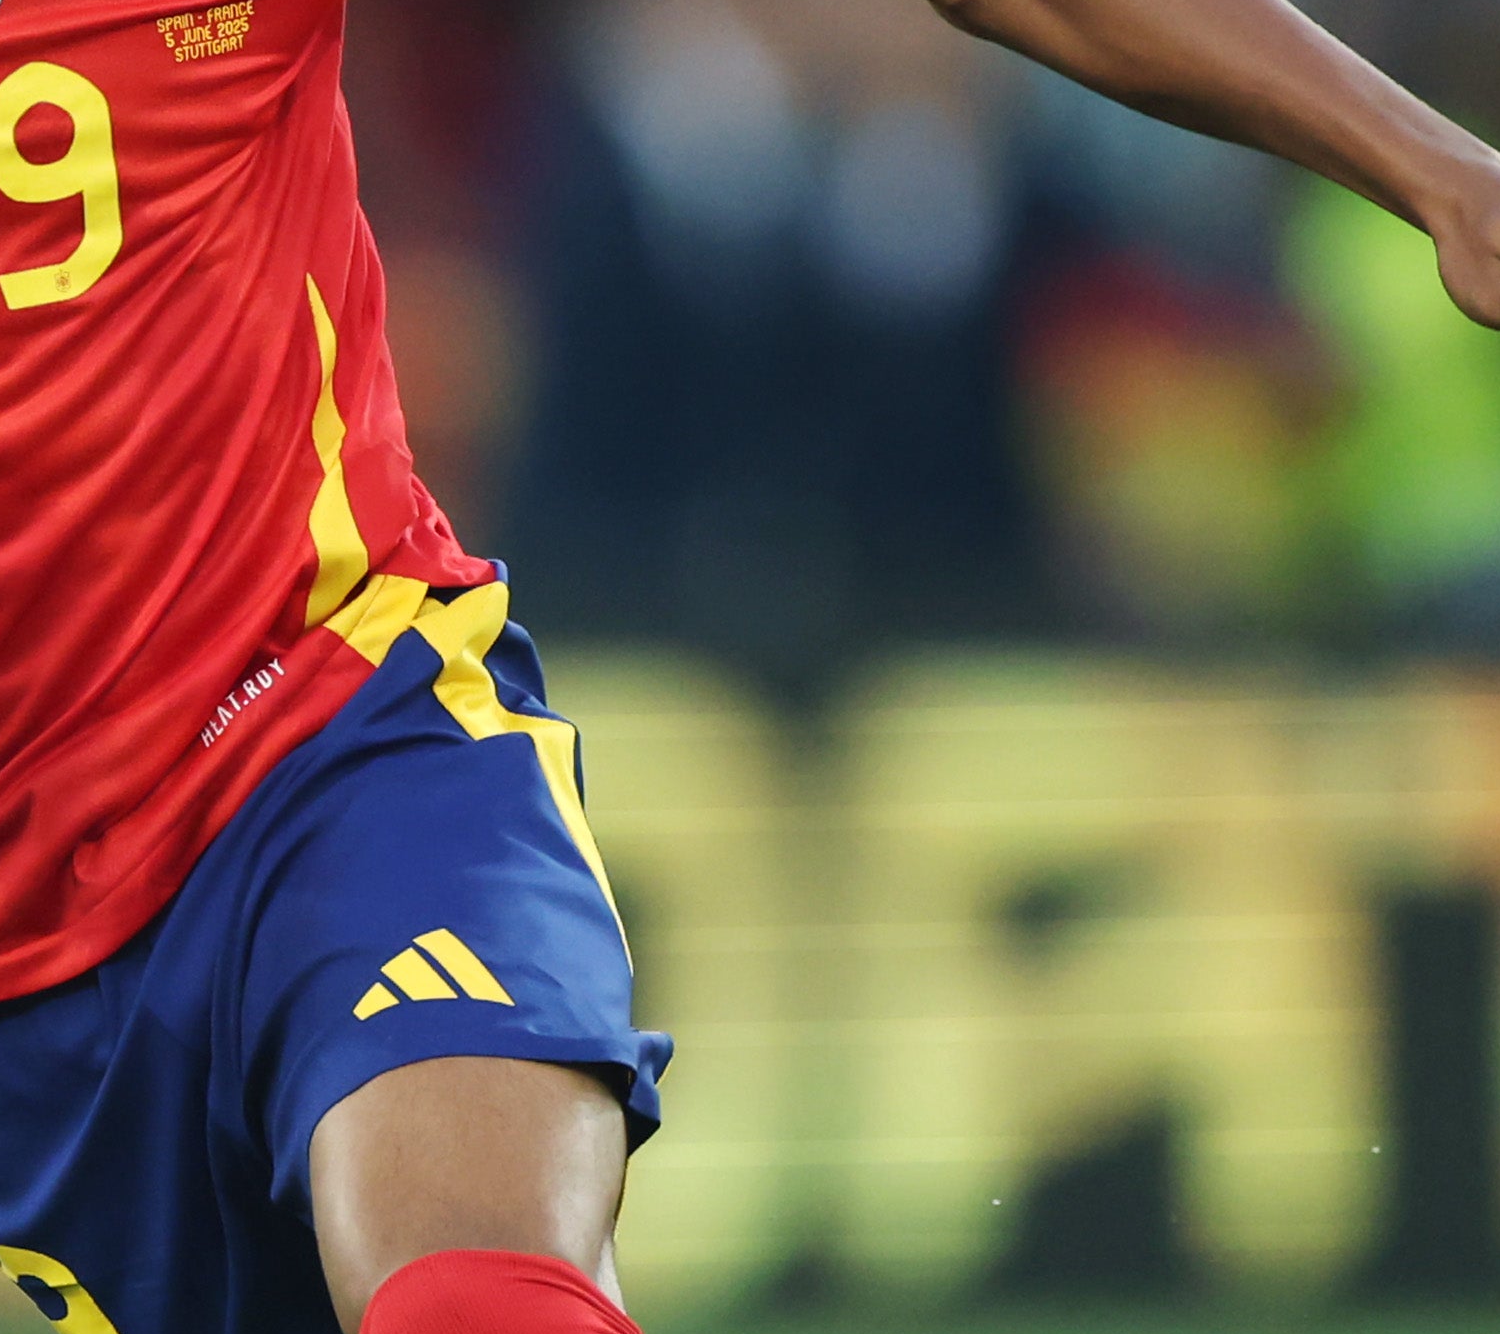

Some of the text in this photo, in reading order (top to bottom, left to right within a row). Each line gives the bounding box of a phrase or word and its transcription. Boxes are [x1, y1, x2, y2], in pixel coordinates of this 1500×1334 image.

[156, 13, 195, 33] SPAIN
[206, 0, 255, 24] FRANCE
[164, 17, 250, 48] 5 JUNE 2025
[174, 34, 244, 62] STUTTGART
